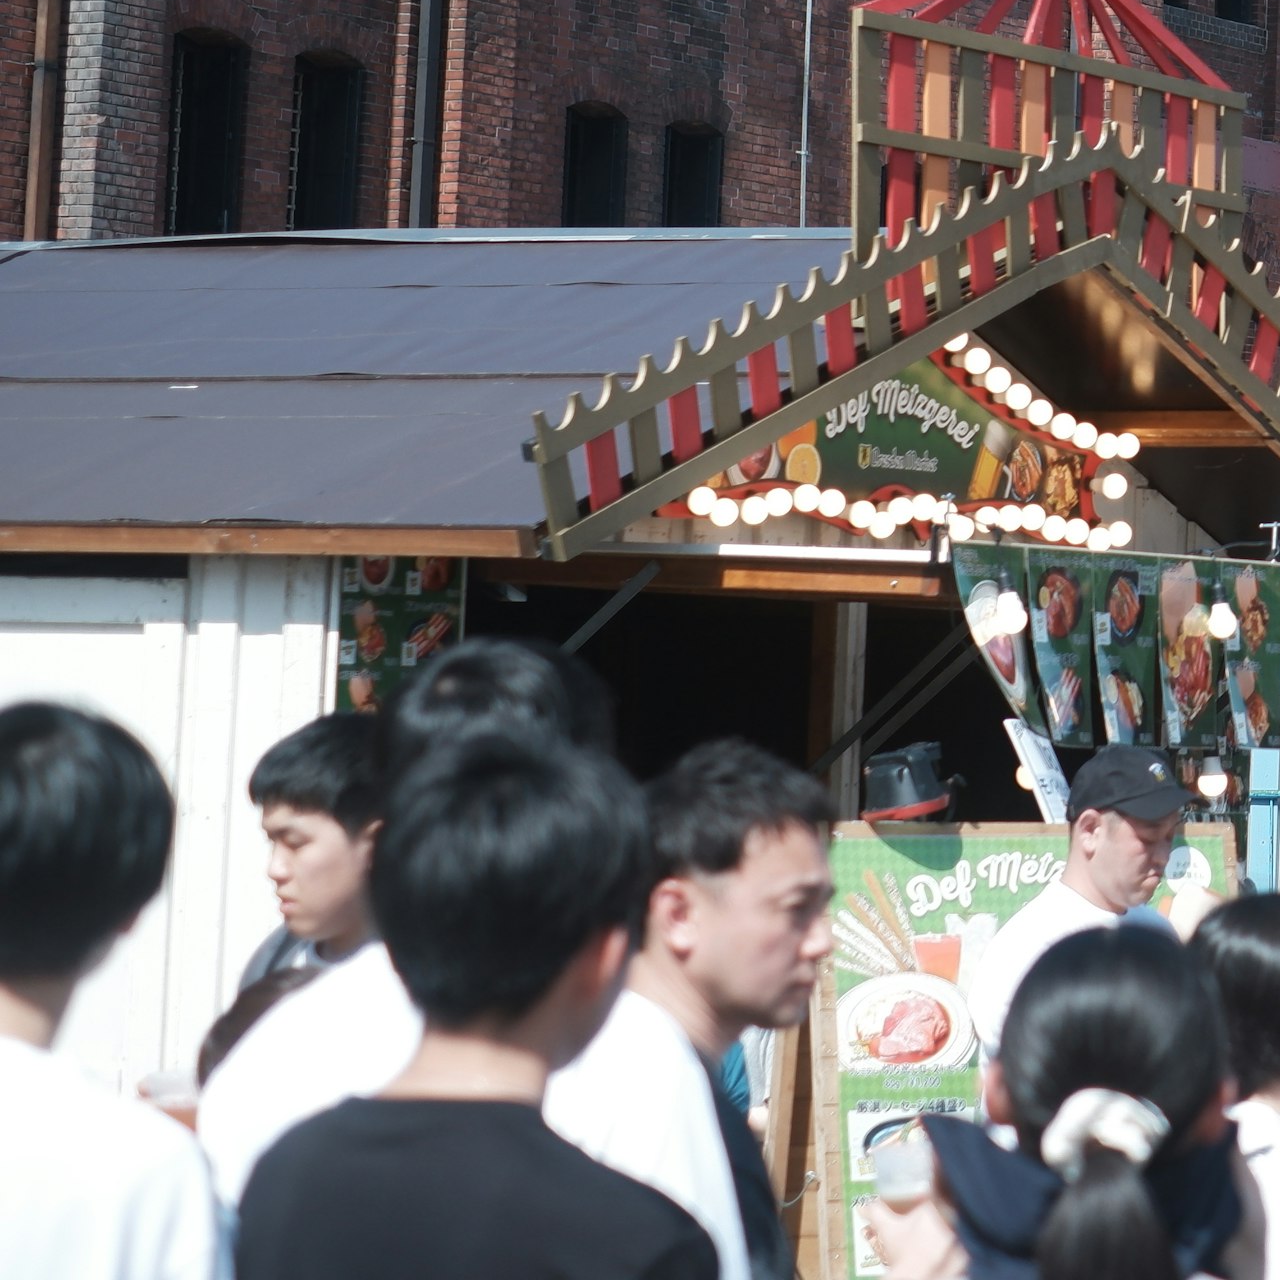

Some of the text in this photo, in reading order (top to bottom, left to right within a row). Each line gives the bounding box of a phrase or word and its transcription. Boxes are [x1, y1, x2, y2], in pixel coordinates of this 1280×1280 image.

[825, 379, 980, 449] Def Mëtzgerei
[905, 859, 977, 917] Def
